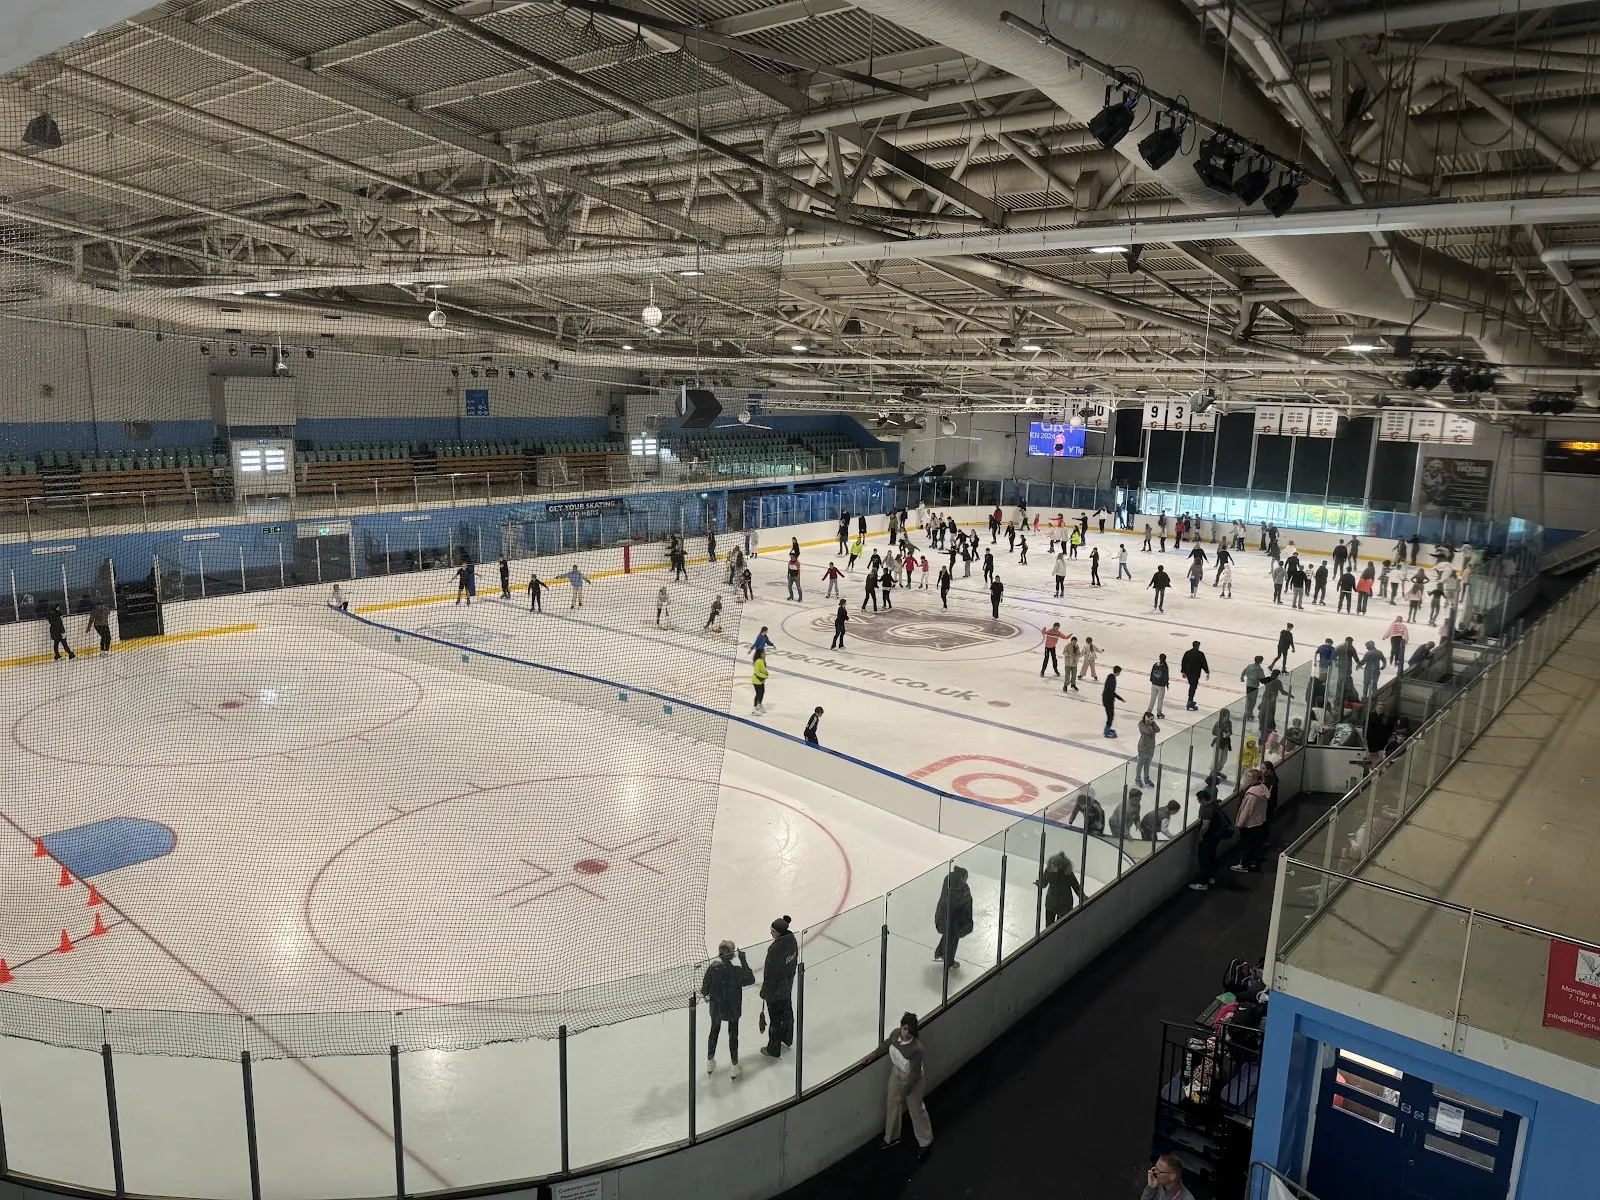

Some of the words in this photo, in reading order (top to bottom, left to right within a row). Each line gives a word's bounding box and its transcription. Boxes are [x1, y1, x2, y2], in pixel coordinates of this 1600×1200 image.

[1151, 405, 1159, 418] 9
[1175, 406, 1184, 419] 3
[548, 505, 563, 513] GET
[565, 503, 585, 511] YOUR
[586, 501, 615, 510] SKATING
[581, 509, 599, 517] HERE
[1561, 985, 1590, 998] Monday
[1568, 994, 1595, 1007] 7.15pm
[1573, 1011, 1596, 1023] 07745
[1183, 1053, 1192, 1078] Roots
[557, 1185, 583, 1194] Customer
